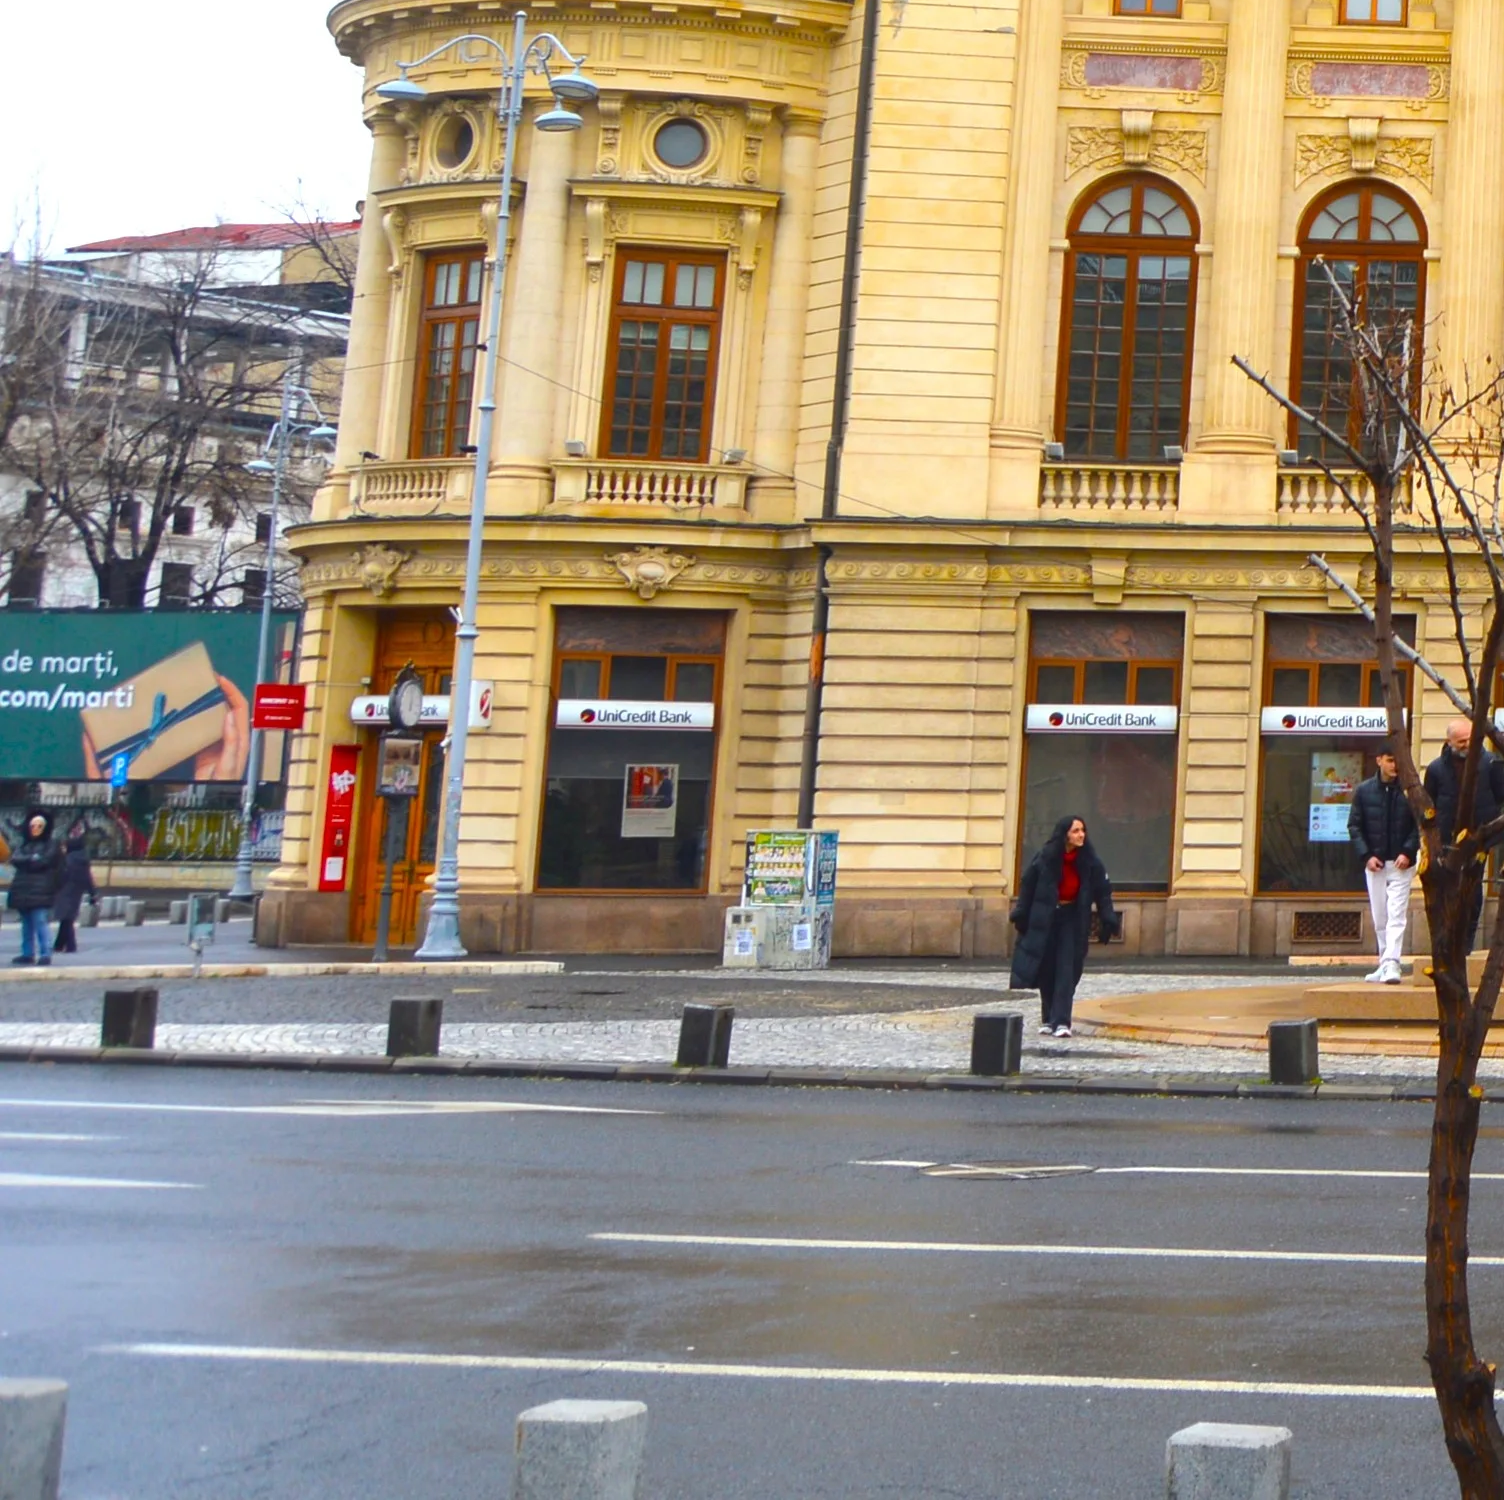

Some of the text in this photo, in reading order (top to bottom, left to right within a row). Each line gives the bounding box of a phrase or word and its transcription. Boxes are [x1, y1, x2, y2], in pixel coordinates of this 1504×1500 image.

[2, 648, 33, 674] de
[597, 709, 692, 724] UniCredit Bank
[1065, 712, 1157, 727] UniCredit Bank
[1298, 714, 1387, 728] UniCredit Bank
